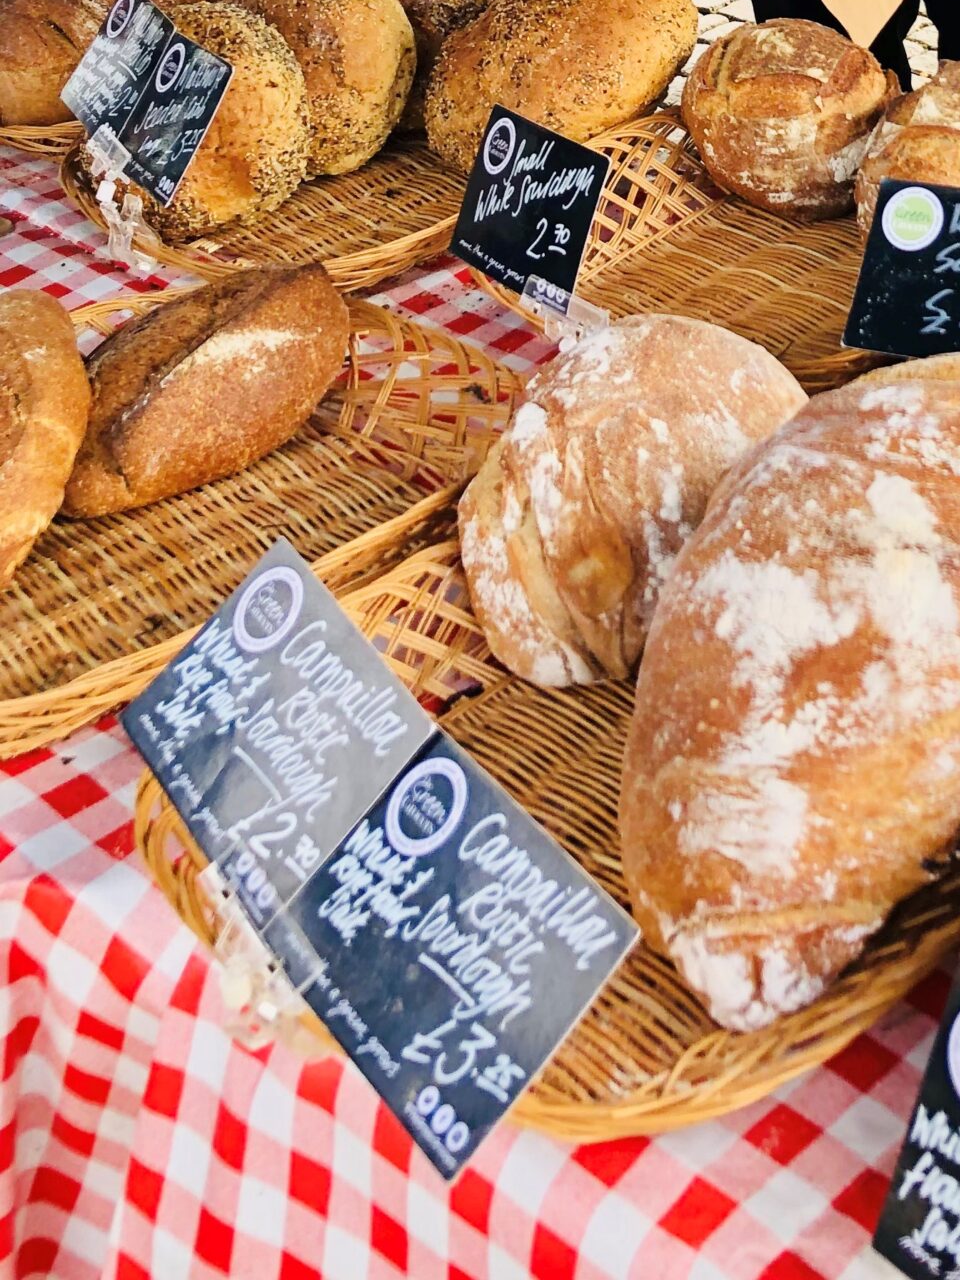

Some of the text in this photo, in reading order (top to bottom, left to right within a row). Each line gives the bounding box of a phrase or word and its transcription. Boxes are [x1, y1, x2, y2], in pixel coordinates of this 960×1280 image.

[474, 165, 595, 222] White Sourdough
[504, 139, 555, 186] Small
[894, 205, 932, 222] Green
[257, 587, 285, 623] Green
[194, 618, 259, 685] Wheat
[277, 687, 349, 764] Rustic
[236, 705, 338, 823] Sourdough
[412, 782, 446, 822] Green
[345, 819, 417, 887] Wheat
[459, 883, 545, 974] Rustic
[403, 895, 532, 1031] Sourdough
